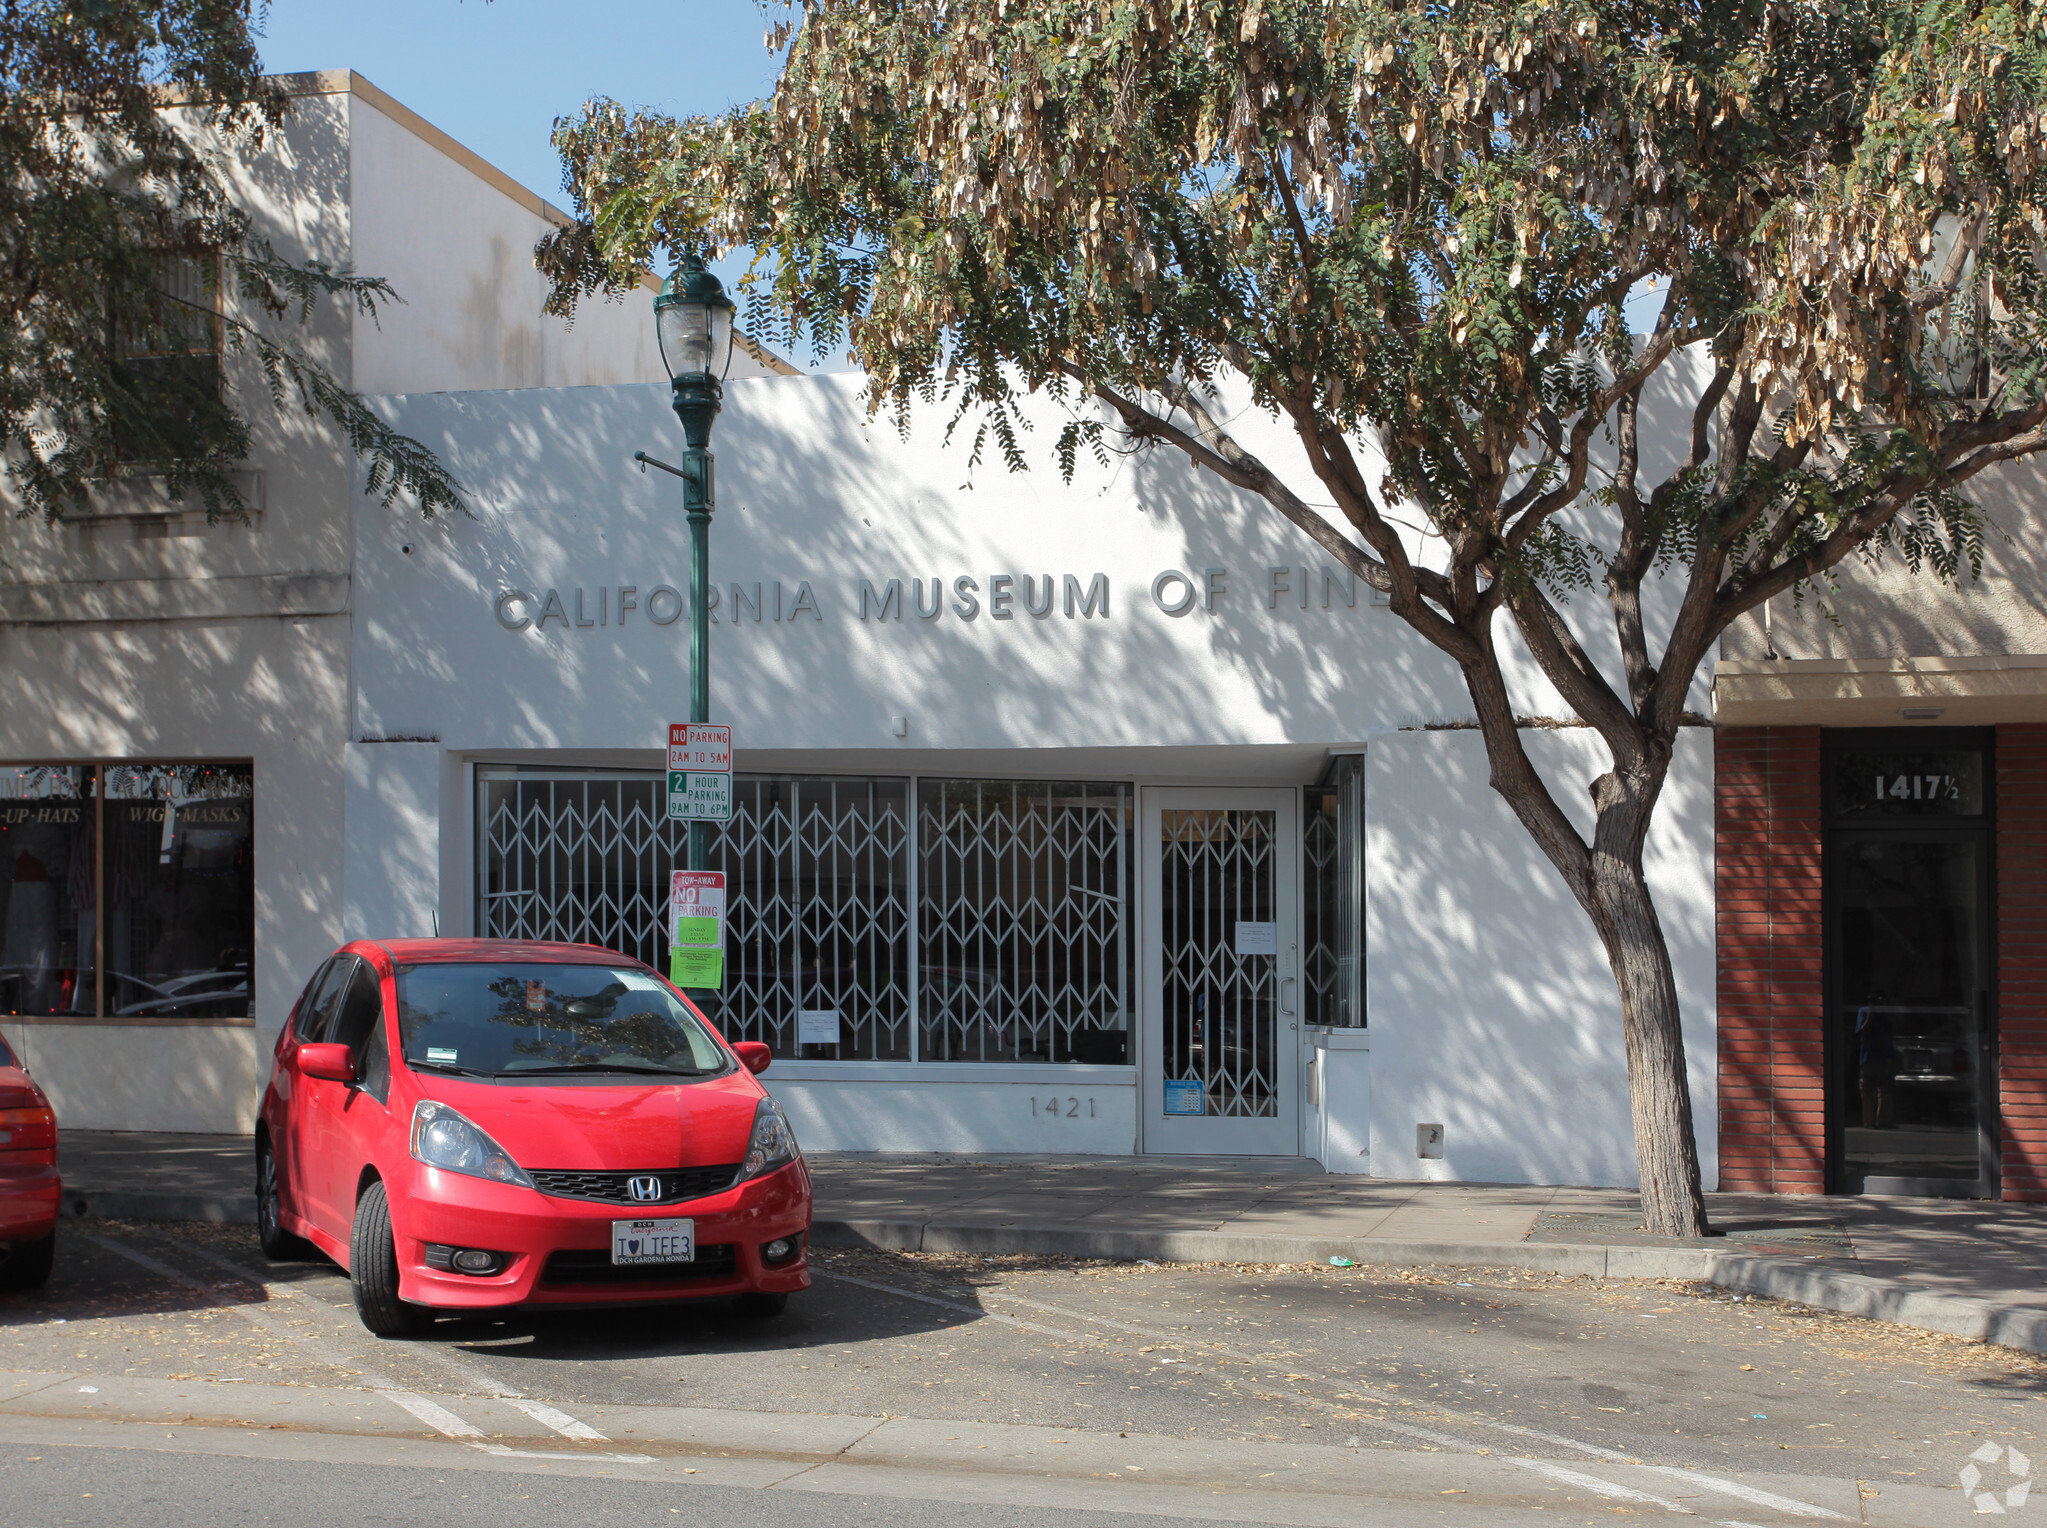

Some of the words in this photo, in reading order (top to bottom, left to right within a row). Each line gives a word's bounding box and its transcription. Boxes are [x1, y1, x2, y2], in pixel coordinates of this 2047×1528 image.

[494, 581, 823, 630] CALIFORNIA
[858, 572, 1110, 621] MUSEUM
[1150, 567, 1227, 616] OF
[673, 729, 687, 742] NO
[690, 732, 728, 744] PARKING
[671, 751, 690, 762] 2AM
[695, 752, 705, 763] TO
[710, 752, 728, 764] 5AM
[48, 777, 83, 800] FOR
[674, 774, 683, 792] 2
[695, 777, 719, 788] HOUR
[688, 790, 726, 802] PARKING
[182, 807, 242, 823] MASKS
[671, 802, 690, 814] 9AM
[695, 803, 705, 814] TO
[710, 803, 728, 815] 6PM
[681, 876, 717, 885] TOW-AWAY
[675, 887, 696, 902] NO
[679, 905, 718, 917] PARKING
[1030, 1096, 1095, 1118] 1421
[634, 1255, 665, 1263] GARDENA
[666, 1254, 690, 1262] HONDA
